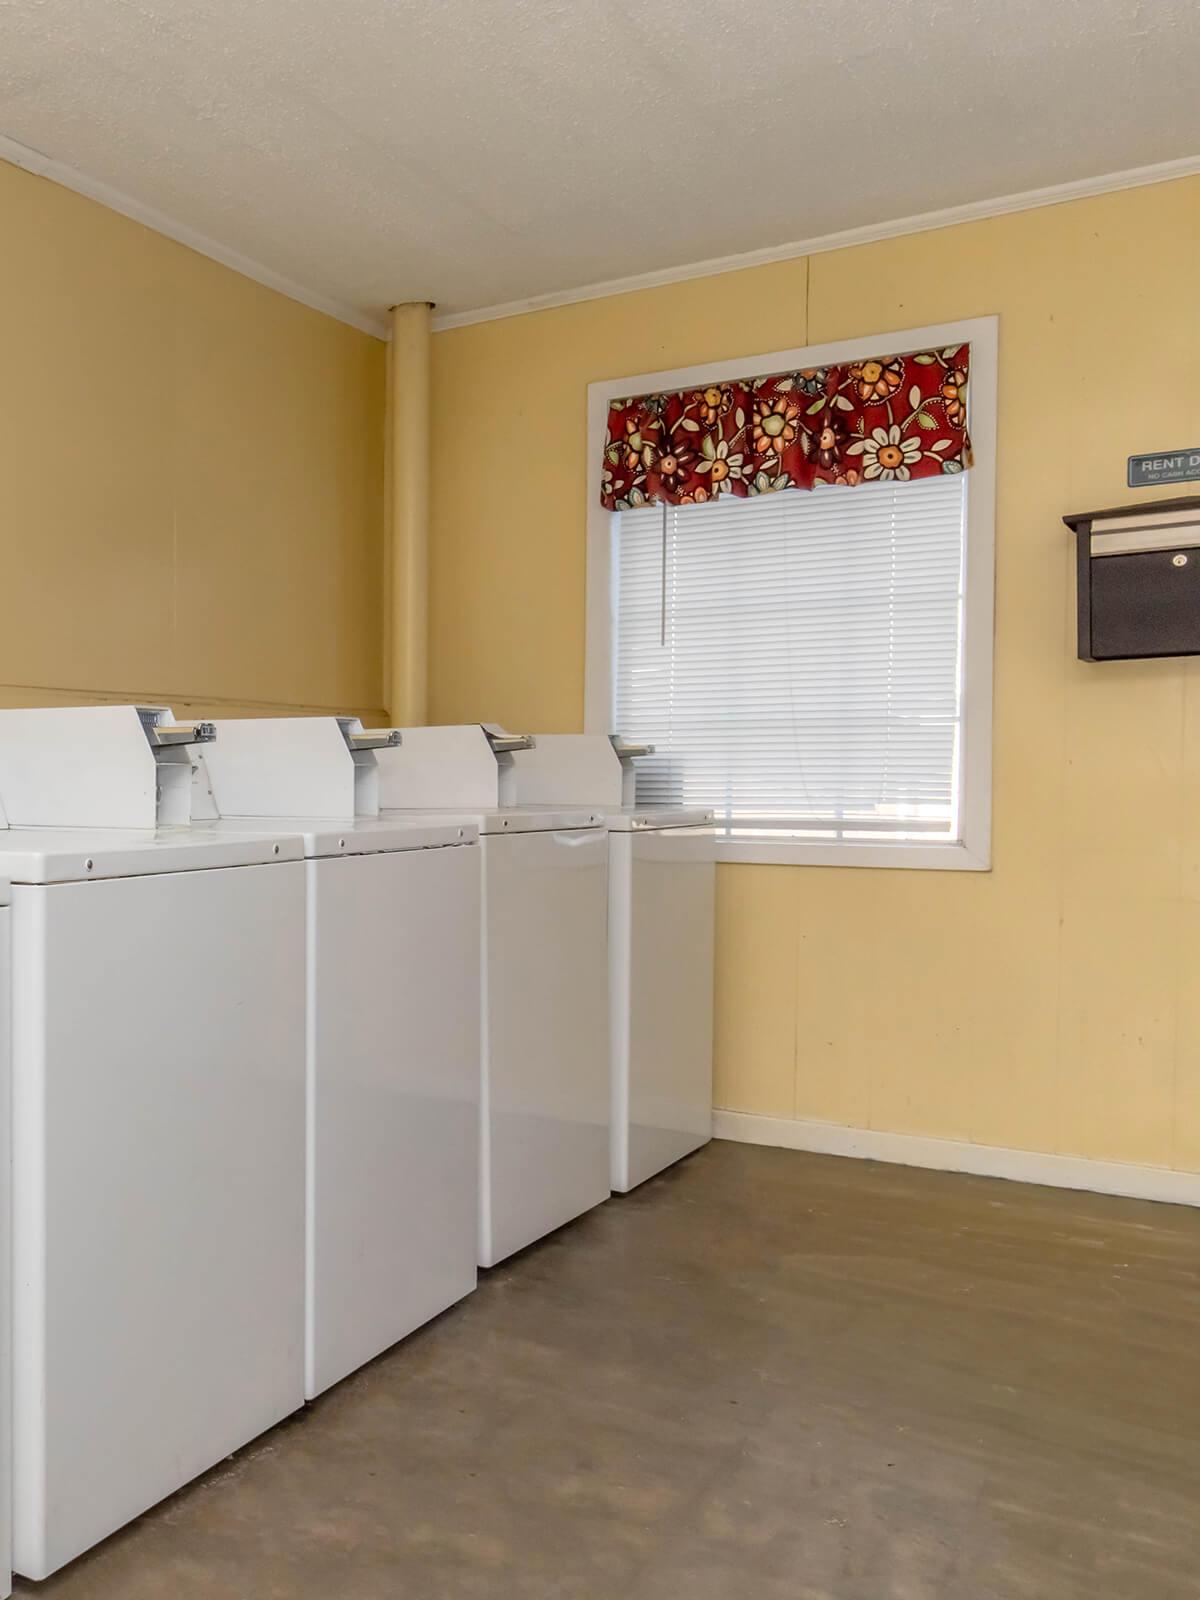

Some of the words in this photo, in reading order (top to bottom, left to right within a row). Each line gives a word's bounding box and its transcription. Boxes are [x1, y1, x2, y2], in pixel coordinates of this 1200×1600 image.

[1142, 457, 1184, 471] RENT
[1148, 472, 1160, 480] NO
[1161, 471, 1184, 479] CASH
